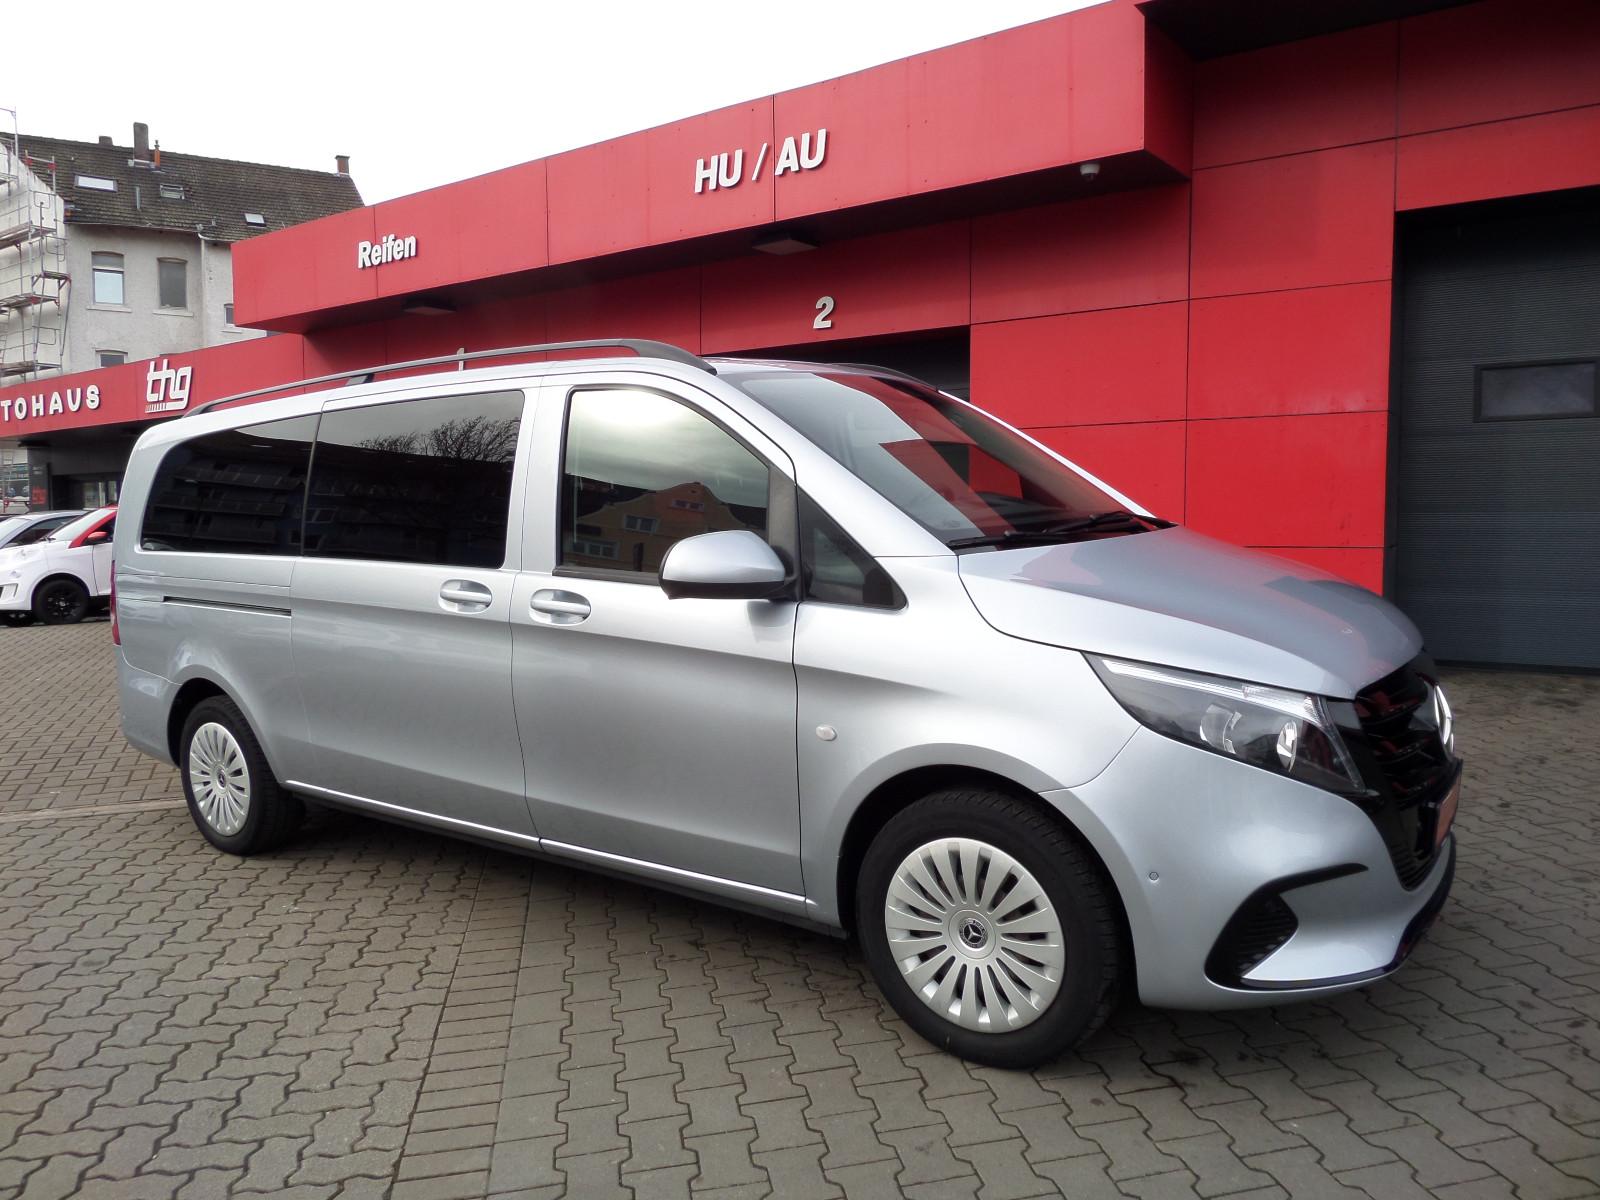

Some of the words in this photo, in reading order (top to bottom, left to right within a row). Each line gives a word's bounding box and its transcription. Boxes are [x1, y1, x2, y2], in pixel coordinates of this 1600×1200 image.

[694, 148, 743, 193] HU
[751, 142, 768, 181] /
[774, 128, 827, 176] AU
[357, 233, 417, 269] Reifen
[813, 296, 835, 329] 2
[0, 384, 100, 421] TOHAUS
